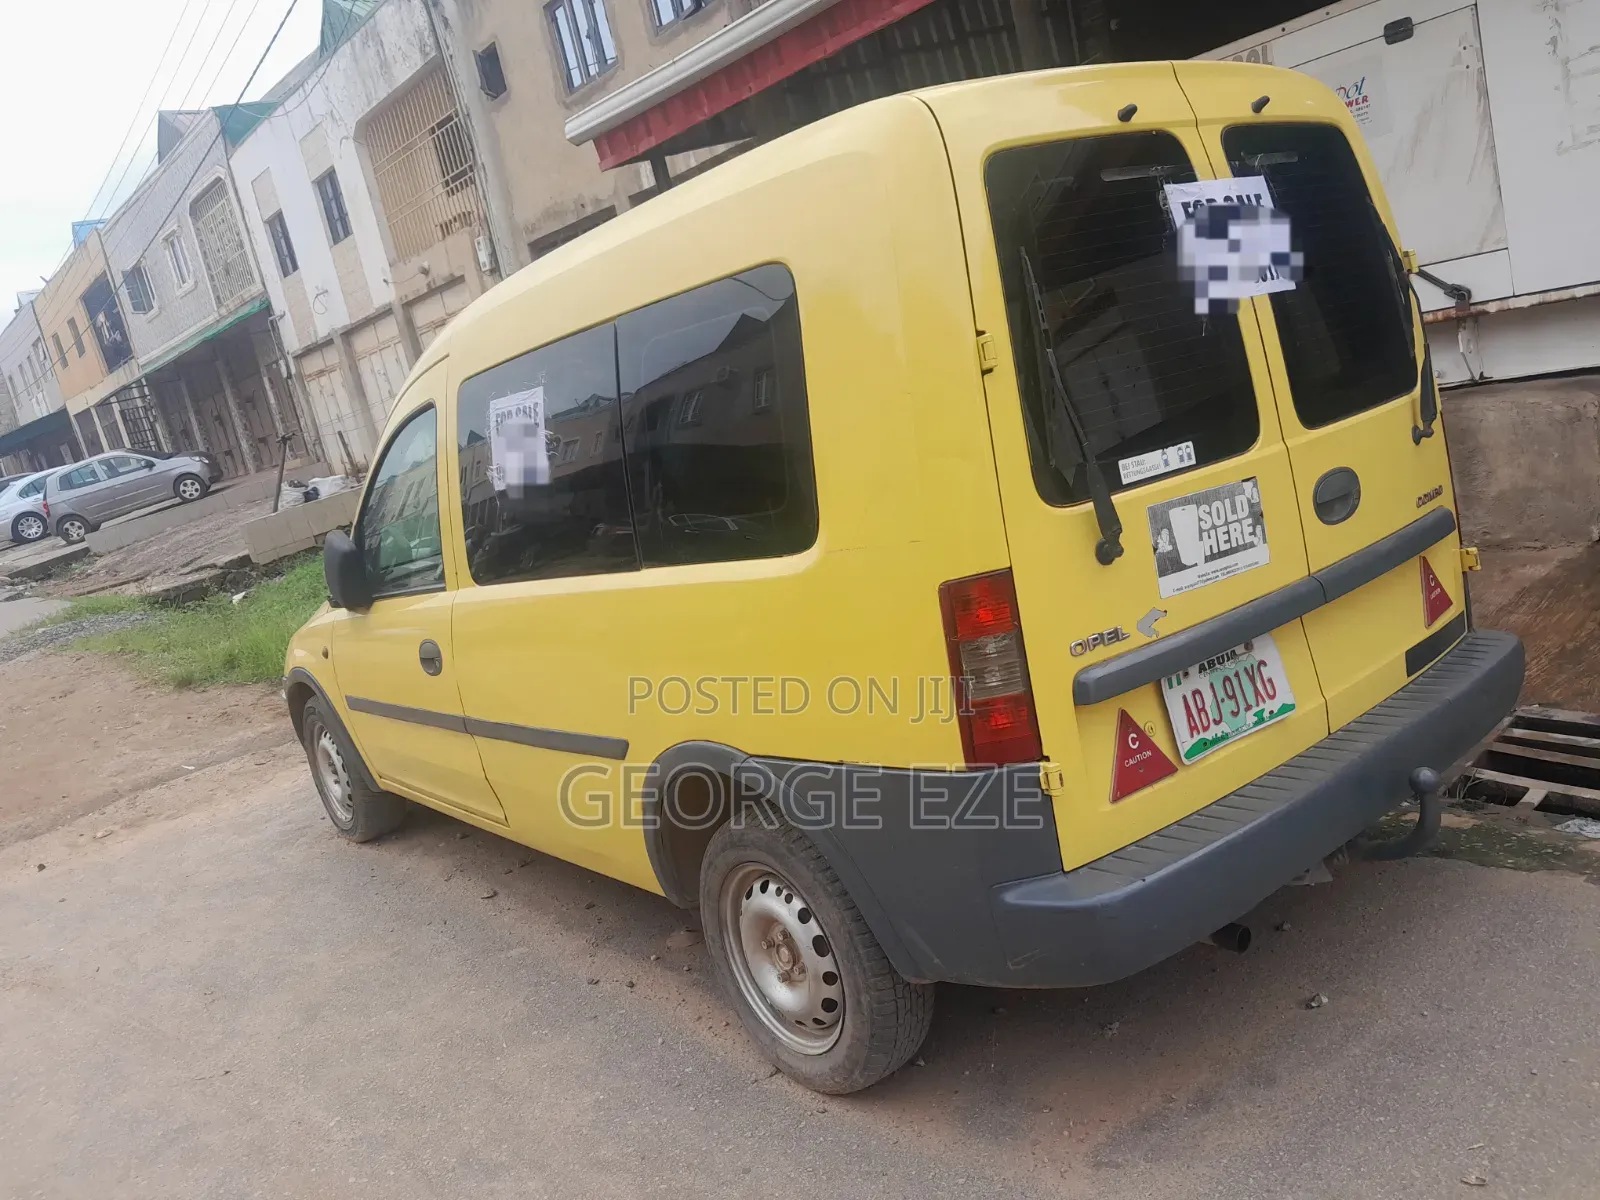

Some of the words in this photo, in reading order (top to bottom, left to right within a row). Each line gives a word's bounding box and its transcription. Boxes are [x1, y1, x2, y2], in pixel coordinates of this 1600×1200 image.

[1345, 95, 1369, 108] WER
[1198, 494, 1249, 530] SOLD
[1201, 517, 1255, 556] HERE
[1069, 625, 1131, 657] OPEL
[1198, 649, 1238, 674] ABUJA
[1181, 659, 1278, 739] ABJ-91XG
[1128, 733, 1139, 749] C
[1124, 749, 1152, 768] CAUTION
